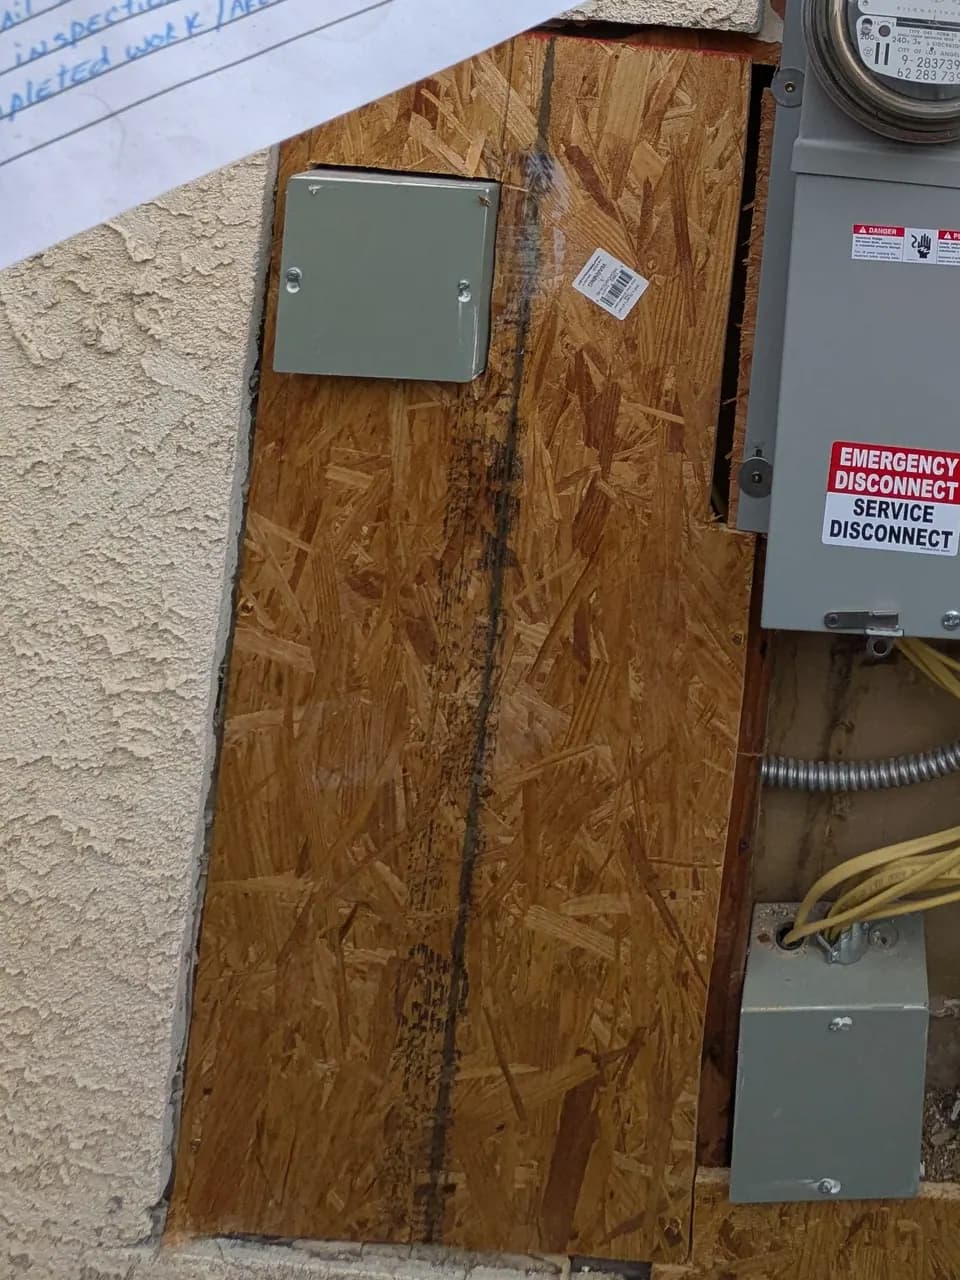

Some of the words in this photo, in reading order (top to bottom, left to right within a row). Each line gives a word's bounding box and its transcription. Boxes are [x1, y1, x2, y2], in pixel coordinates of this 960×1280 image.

[868, 227, 897, 236] DANGER
[839, 447, 960, 477] EMERGENCY
[834, 470, 959, 500] DISCONNECT
[853, 498, 935, 524] SERVICE
[829, 519, 953, 549] DISCONNECT
